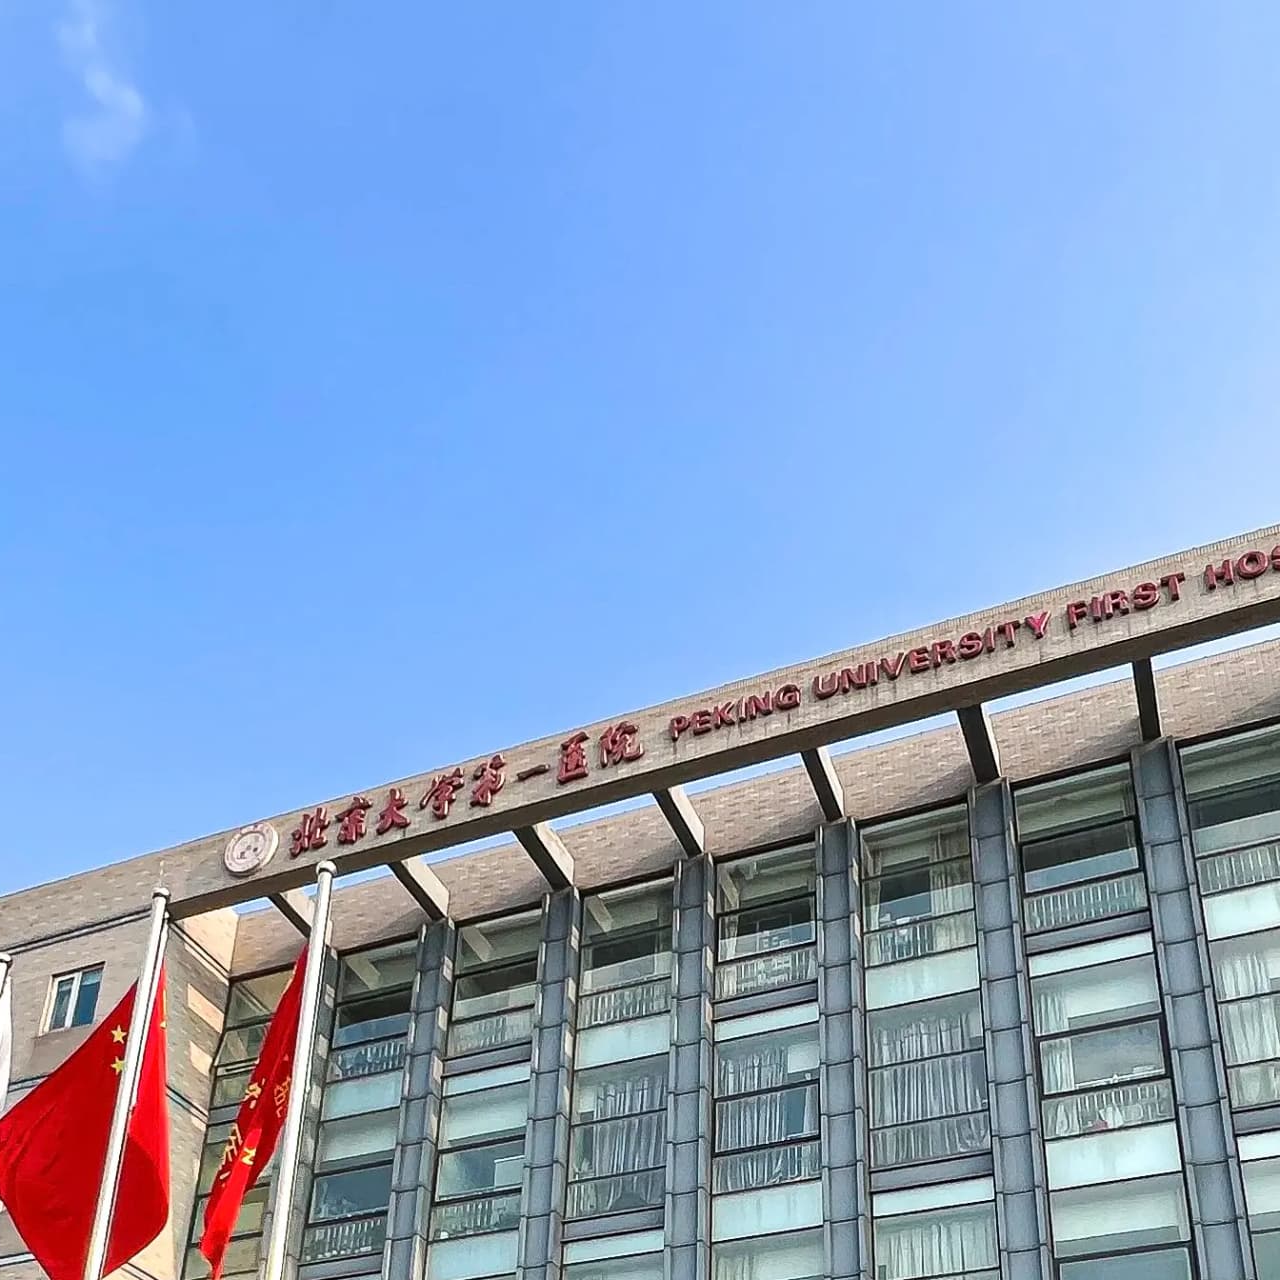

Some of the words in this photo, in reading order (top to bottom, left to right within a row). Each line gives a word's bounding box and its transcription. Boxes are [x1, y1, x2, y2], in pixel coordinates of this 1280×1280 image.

[669, 682, 801, 742] PEKING
[812, 609, 1050, 701] UNIVERSITY
[1066, 572, 1187, 630] FIRST
[289, 720, 644, 858] 北京大学第一医院
